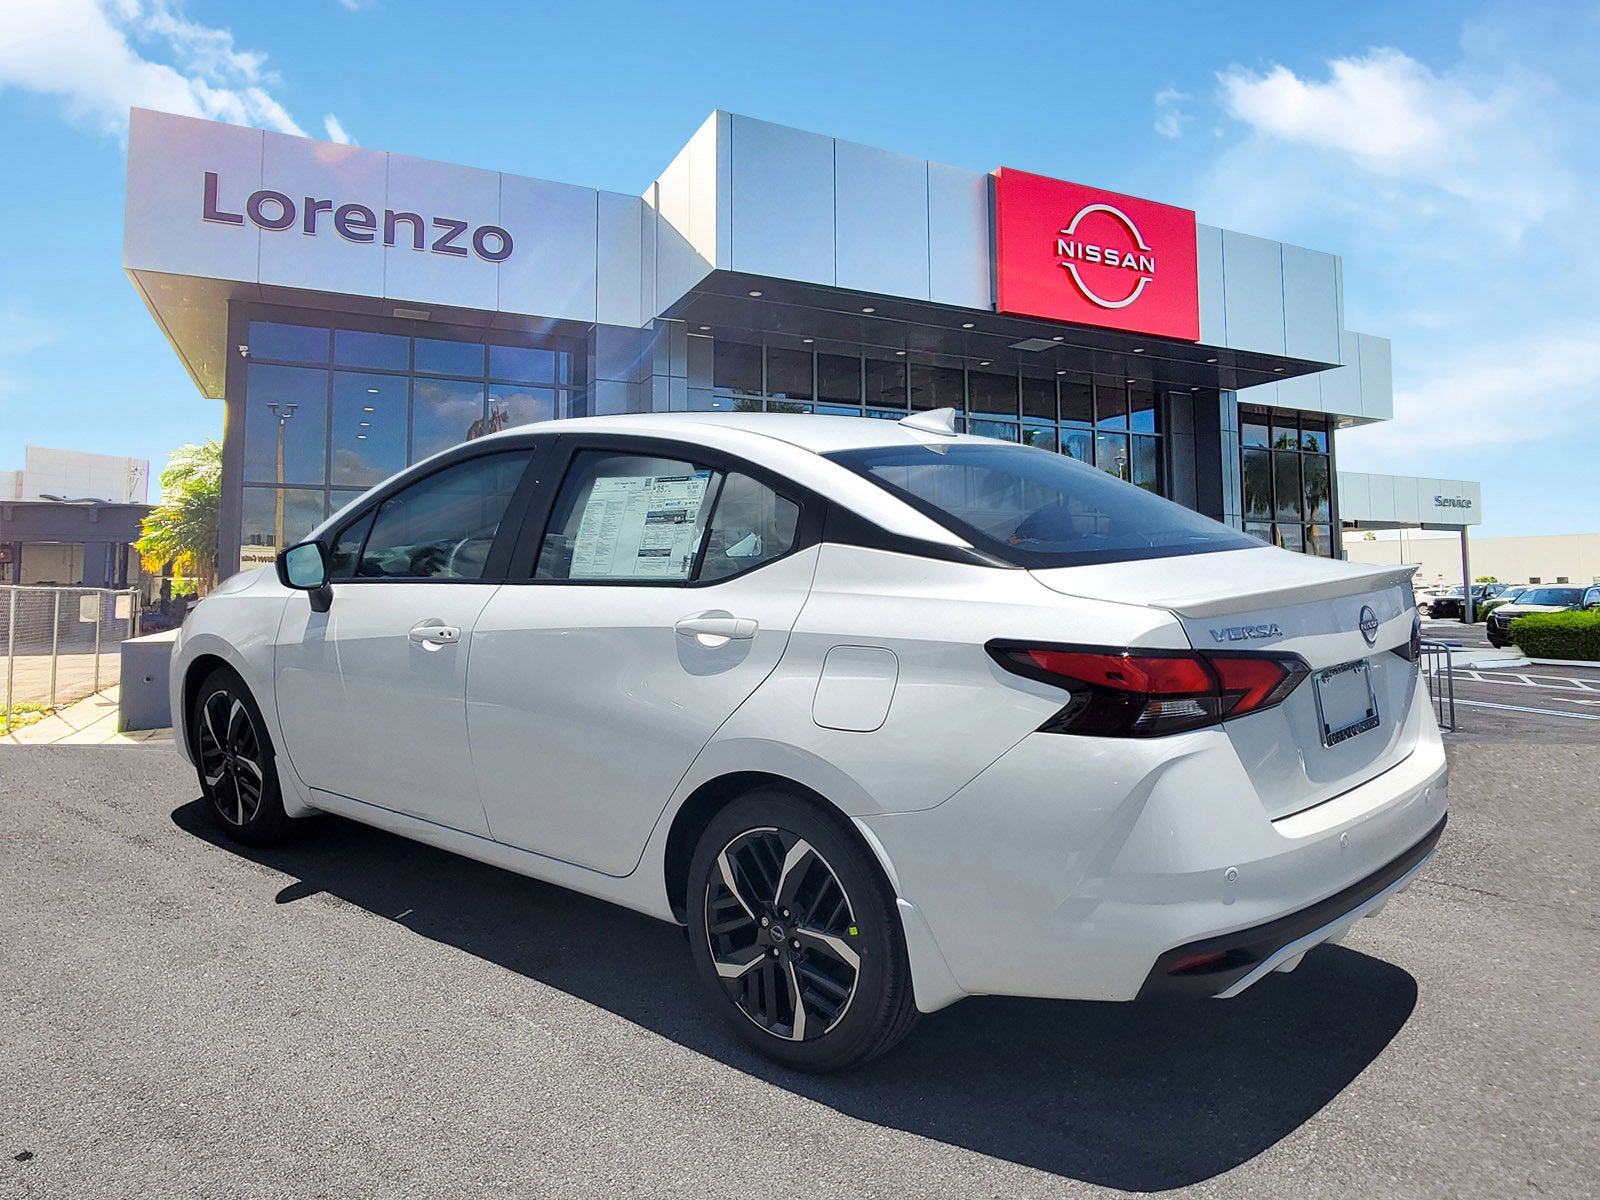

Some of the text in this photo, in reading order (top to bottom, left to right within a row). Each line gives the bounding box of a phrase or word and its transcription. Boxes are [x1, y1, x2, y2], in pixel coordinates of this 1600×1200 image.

[203, 171, 514, 262] Lorenzo
[1057, 238, 1155, 273] NISSAN
[1434, 495, 1472, 508] Service
[1209, 623, 1284, 642] VERSA
